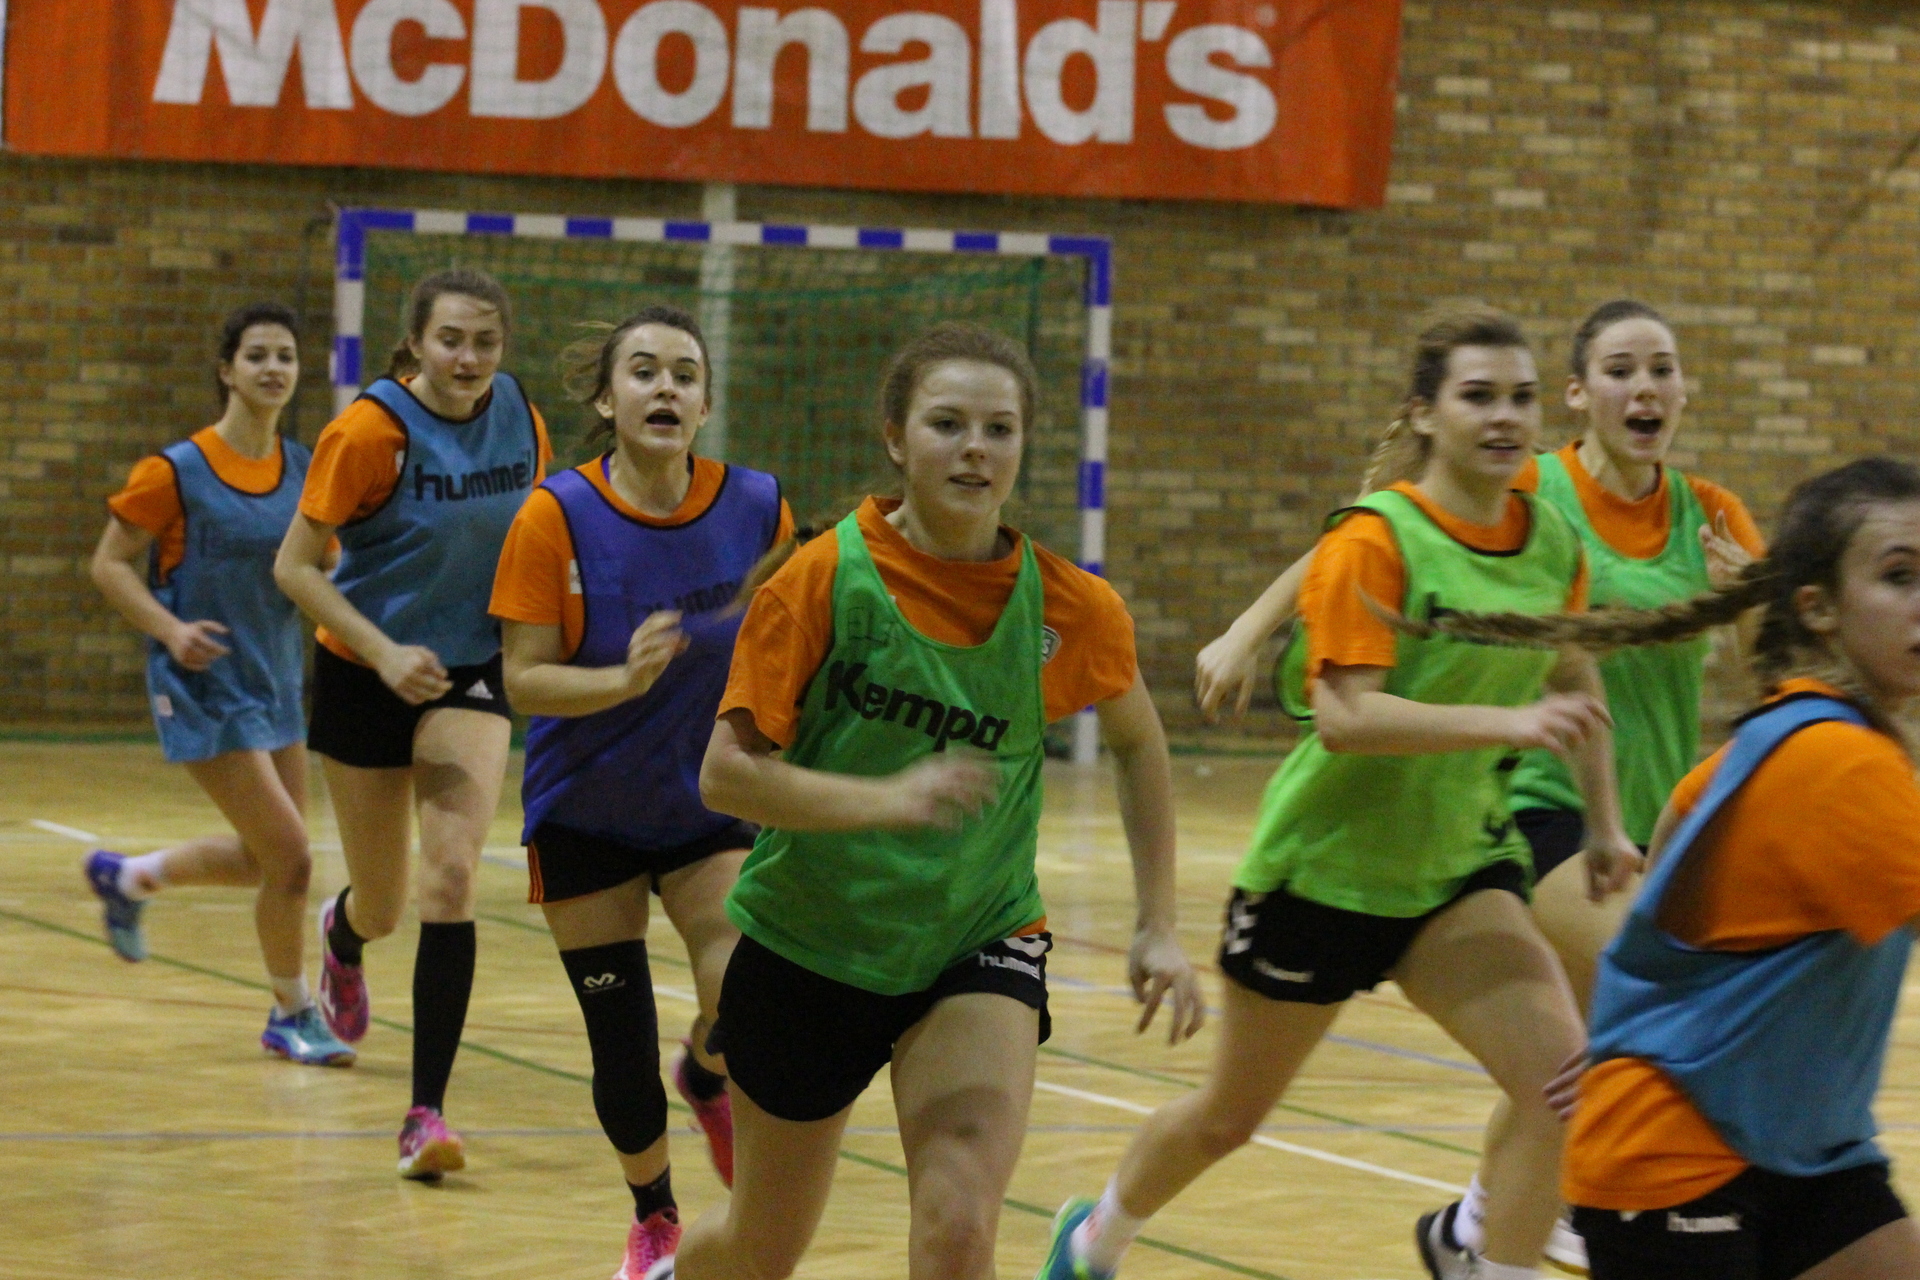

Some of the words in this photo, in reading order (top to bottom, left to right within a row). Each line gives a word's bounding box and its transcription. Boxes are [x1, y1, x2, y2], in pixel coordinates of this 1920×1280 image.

[152, 0, 1279, 151] McDonald's
[824, 660, 1010, 753] Kempa
[979, 951, 1040, 980] hummel
